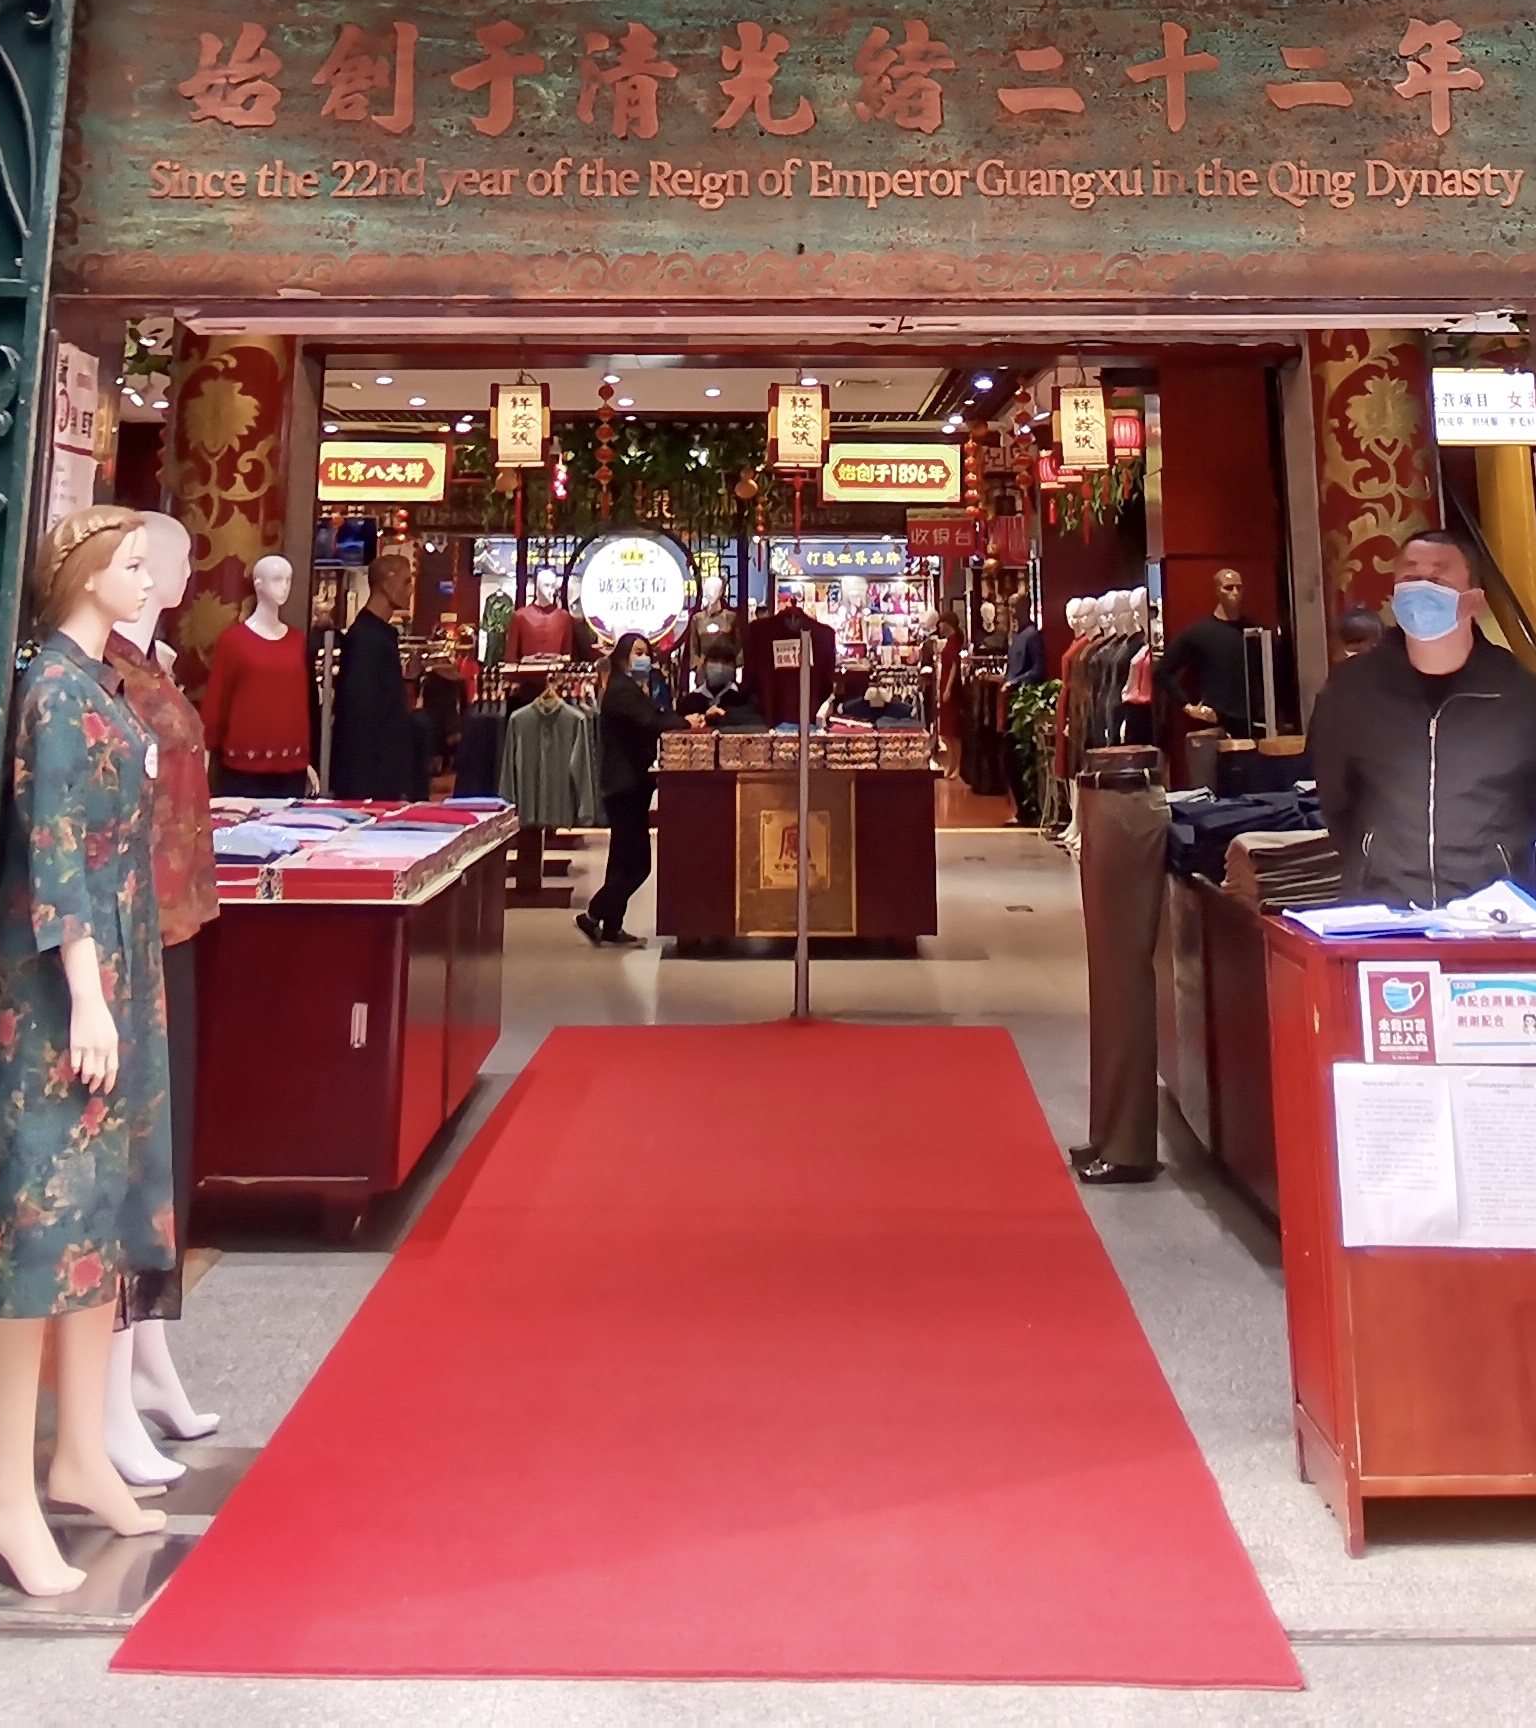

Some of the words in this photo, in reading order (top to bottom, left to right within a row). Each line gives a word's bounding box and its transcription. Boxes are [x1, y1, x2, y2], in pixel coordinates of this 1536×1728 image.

[147, 160, 250, 200] Since
[255, 160, 319, 199] the
[331, 158, 425, 199] 22nd
[436, 170, 520, 207] year
[526, 158, 571, 198] of
[576, 159, 639, 198] the
[648, 160, 750, 211] Reign
[758, 158, 798, 198] of
[810, 160, 970, 209] Emperor
[976, 159, 1145, 209] Guangxu
[1152, 159, 1186, 197] in
[1195, 160, 1258, 198] the
[1267, 160, 1355, 209] Qing
[1366, 159, 1524, 208] Dynasty
[327, 461, 425, 484] 北京八大祥
[837, 463, 947, 484] 始创于1896年
[910, 527, 972, 547] 收银台
[806, 549, 902, 567] 打造世界品牌
[599, 577, 668, 595] 诚实守信
[609, 598, 656, 613] 示范店
[1379, 1032, 1428, 1046] 禁止入内
